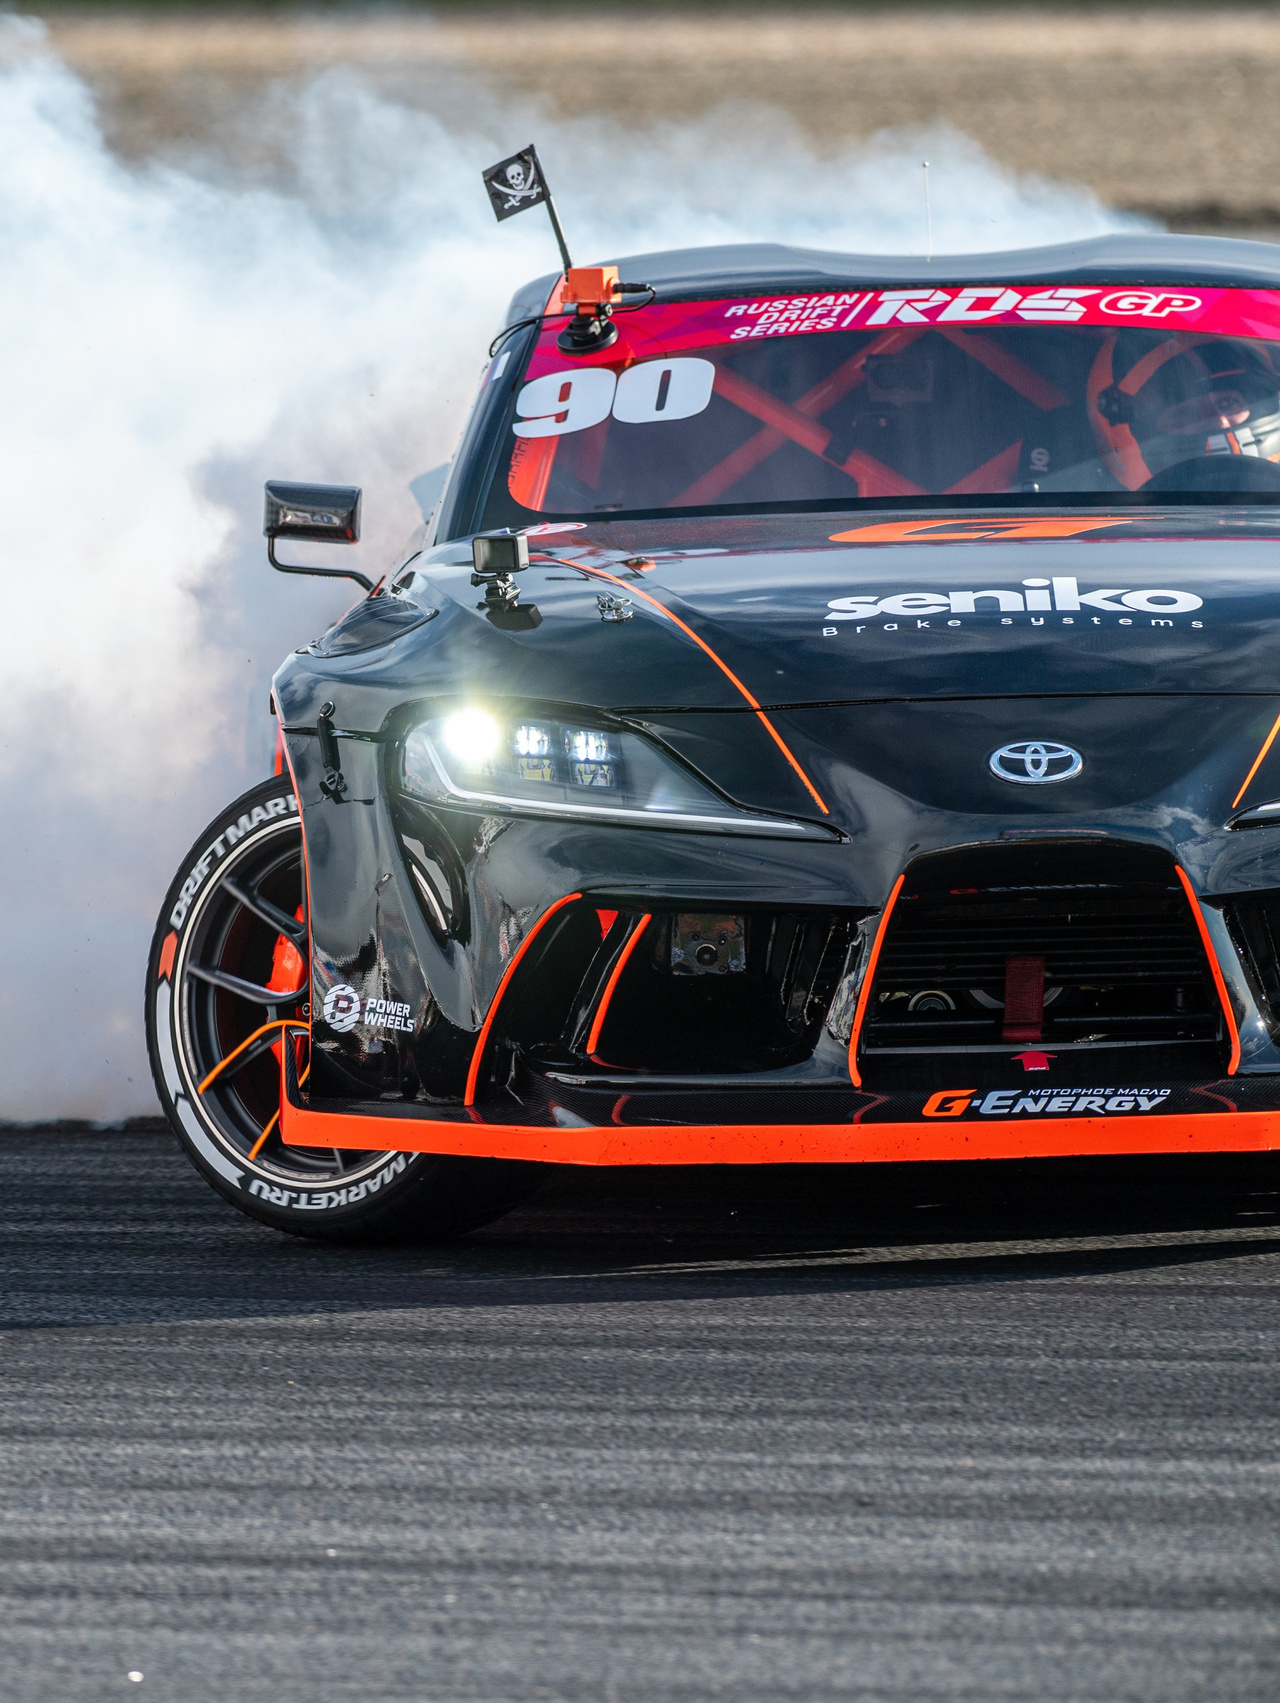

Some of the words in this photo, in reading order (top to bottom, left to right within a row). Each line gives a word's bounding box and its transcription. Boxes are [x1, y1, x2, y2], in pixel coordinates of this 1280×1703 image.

[723, 292, 861, 318] RUSSIAN
[756, 304, 851, 325] DRIFT
[865, 287, 1104, 326] RDS
[1098, 290, 1202, 319] GP
[729, 317, 838, 340] SERIES
[512, 356, 716, 438] 90
[823, 576, 1204, 621] seniko
[822, 616, 962, 637] Brake
[1000, 616, 1204, 629] systems
[365, 997, 411, 1018] POWER
[363, 1011, 415, 1033] WHEELS
[922, 1088, 1168, 1118] G-ENERGY
